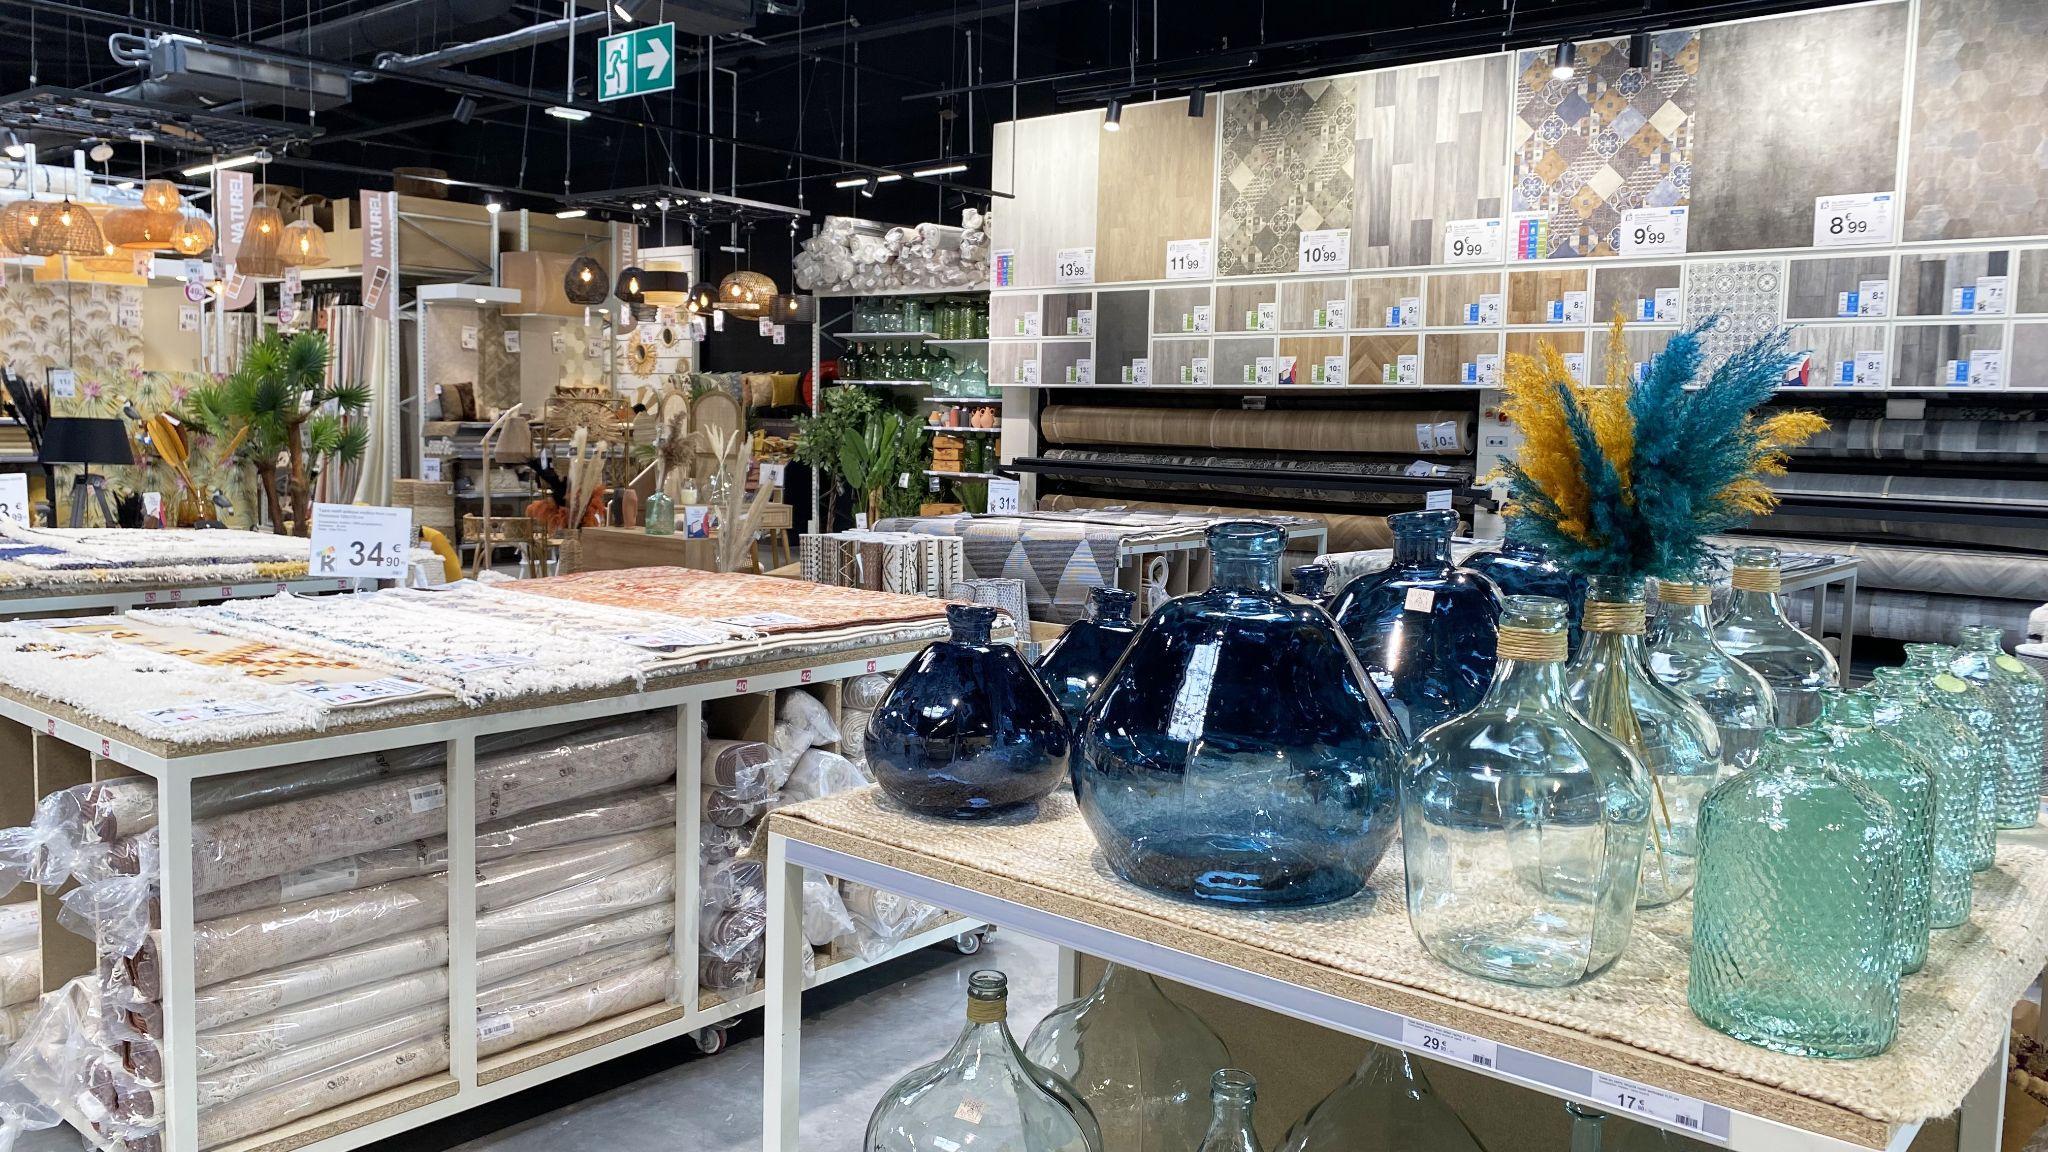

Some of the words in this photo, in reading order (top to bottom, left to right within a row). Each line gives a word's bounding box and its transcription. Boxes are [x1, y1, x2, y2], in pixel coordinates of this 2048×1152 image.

[229, 174, 245, 244] NATUREL
[369, 193, 383, 258] NATUREL
[1829, 217, 1843, 234] 8
[1848, 220, 1867, 234] 99
[1634, 228, 1646, 245] 9
[1648, 232, 1665, 244] 99
[1304, 247, 1321, 263] 10
[1323, 251, 1337, 262] 99
[1453, 240, 1464, 256] 9
[1466, 244, 1482, 256] 99
[1059, 263, 1073, 276] 13
[1074, 266, 1085, 276] 99
[1171, 256, 1184, 270] 11
[1187, 260, 1199, 270] 99
[999, 497, 1010, 510] 31
[349, 540, 384, 567] 34
[386, 556, 400, 567] 90
[867, 662, 876, 671] 41
[801, 672, 811, 681] 42
[736, 681, 747, 691] 40
[1423, 1035, 1440, 1050] 29
[1617, 1093, 1636, 1109] 17
